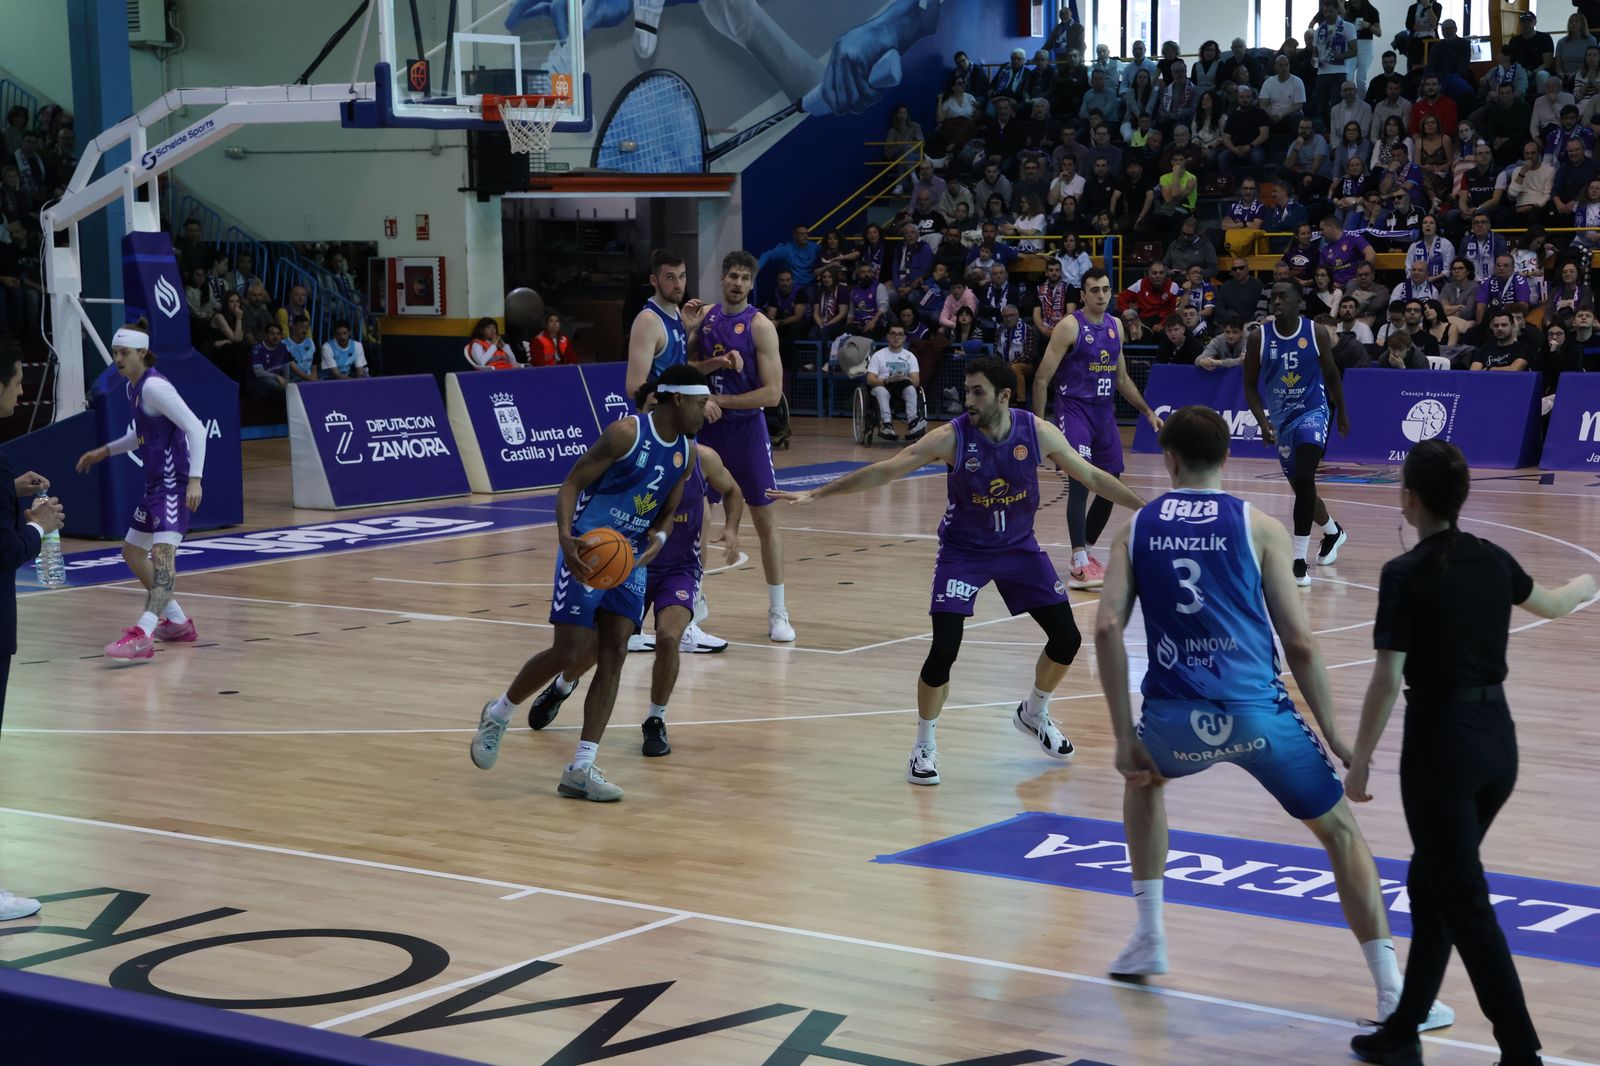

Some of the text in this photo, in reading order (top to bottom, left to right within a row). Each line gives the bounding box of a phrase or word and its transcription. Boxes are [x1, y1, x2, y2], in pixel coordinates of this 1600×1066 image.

[156, 135, 187, 157] Schelde
[187, 120, 214, 139] Sports
[1281, 351, 1299, 370] 15
[1097, 378, 1112, 396] 22
[1401, 390, 1424, 398] Consejo
[530, 425, 583, 442] Junta de
[367, 437, 451, 462] ZAMORA
[500, 442, 588, 462] Castilla y León
[646, 465, 666, 490] 2
[972, 489, 1028, 508] agropal
[609, 507, 631, 522] CAJA
[1159, 498, 1219, 521] gaza
[993, 510, 1006, 532] 11
[190, 515, 477, 554] gaza
[1149, 534, 1228, 551] HANZLÍK
[1172, 558, 1204, 614] 3
[1185, 637, 1239, 652] INNOVA
[1186, 655, 1215, 668] Chef
[1173, 737, 1267, 763] MORALEJO
